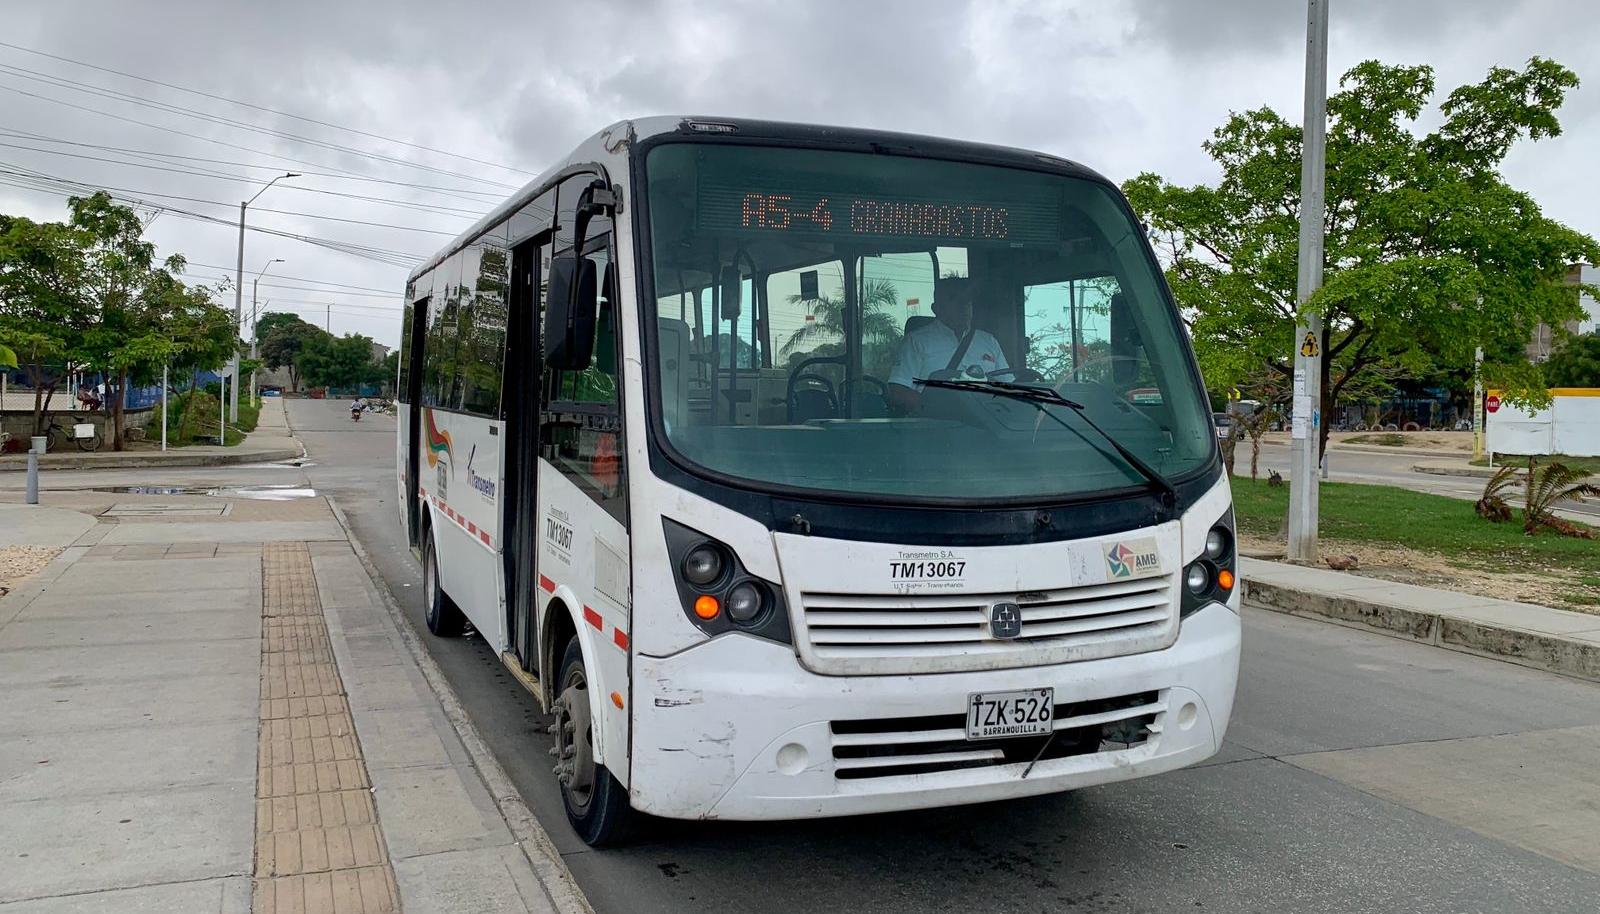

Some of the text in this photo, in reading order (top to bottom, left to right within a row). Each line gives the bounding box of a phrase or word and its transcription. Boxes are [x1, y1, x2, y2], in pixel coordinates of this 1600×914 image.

[743, 194, 1009, 238] A5-4 GRANABASTOS
[547, 518, 573, 551] TM13067
[898, 551, 939, 559] Transmetro
[1136, 553, 1157, 567] AMB
[890, 562, 966, 578] TM13067
[972, 697, 1050, 727] TZK 526
[983, 725, 1037, 736] BARRANQUILLA
